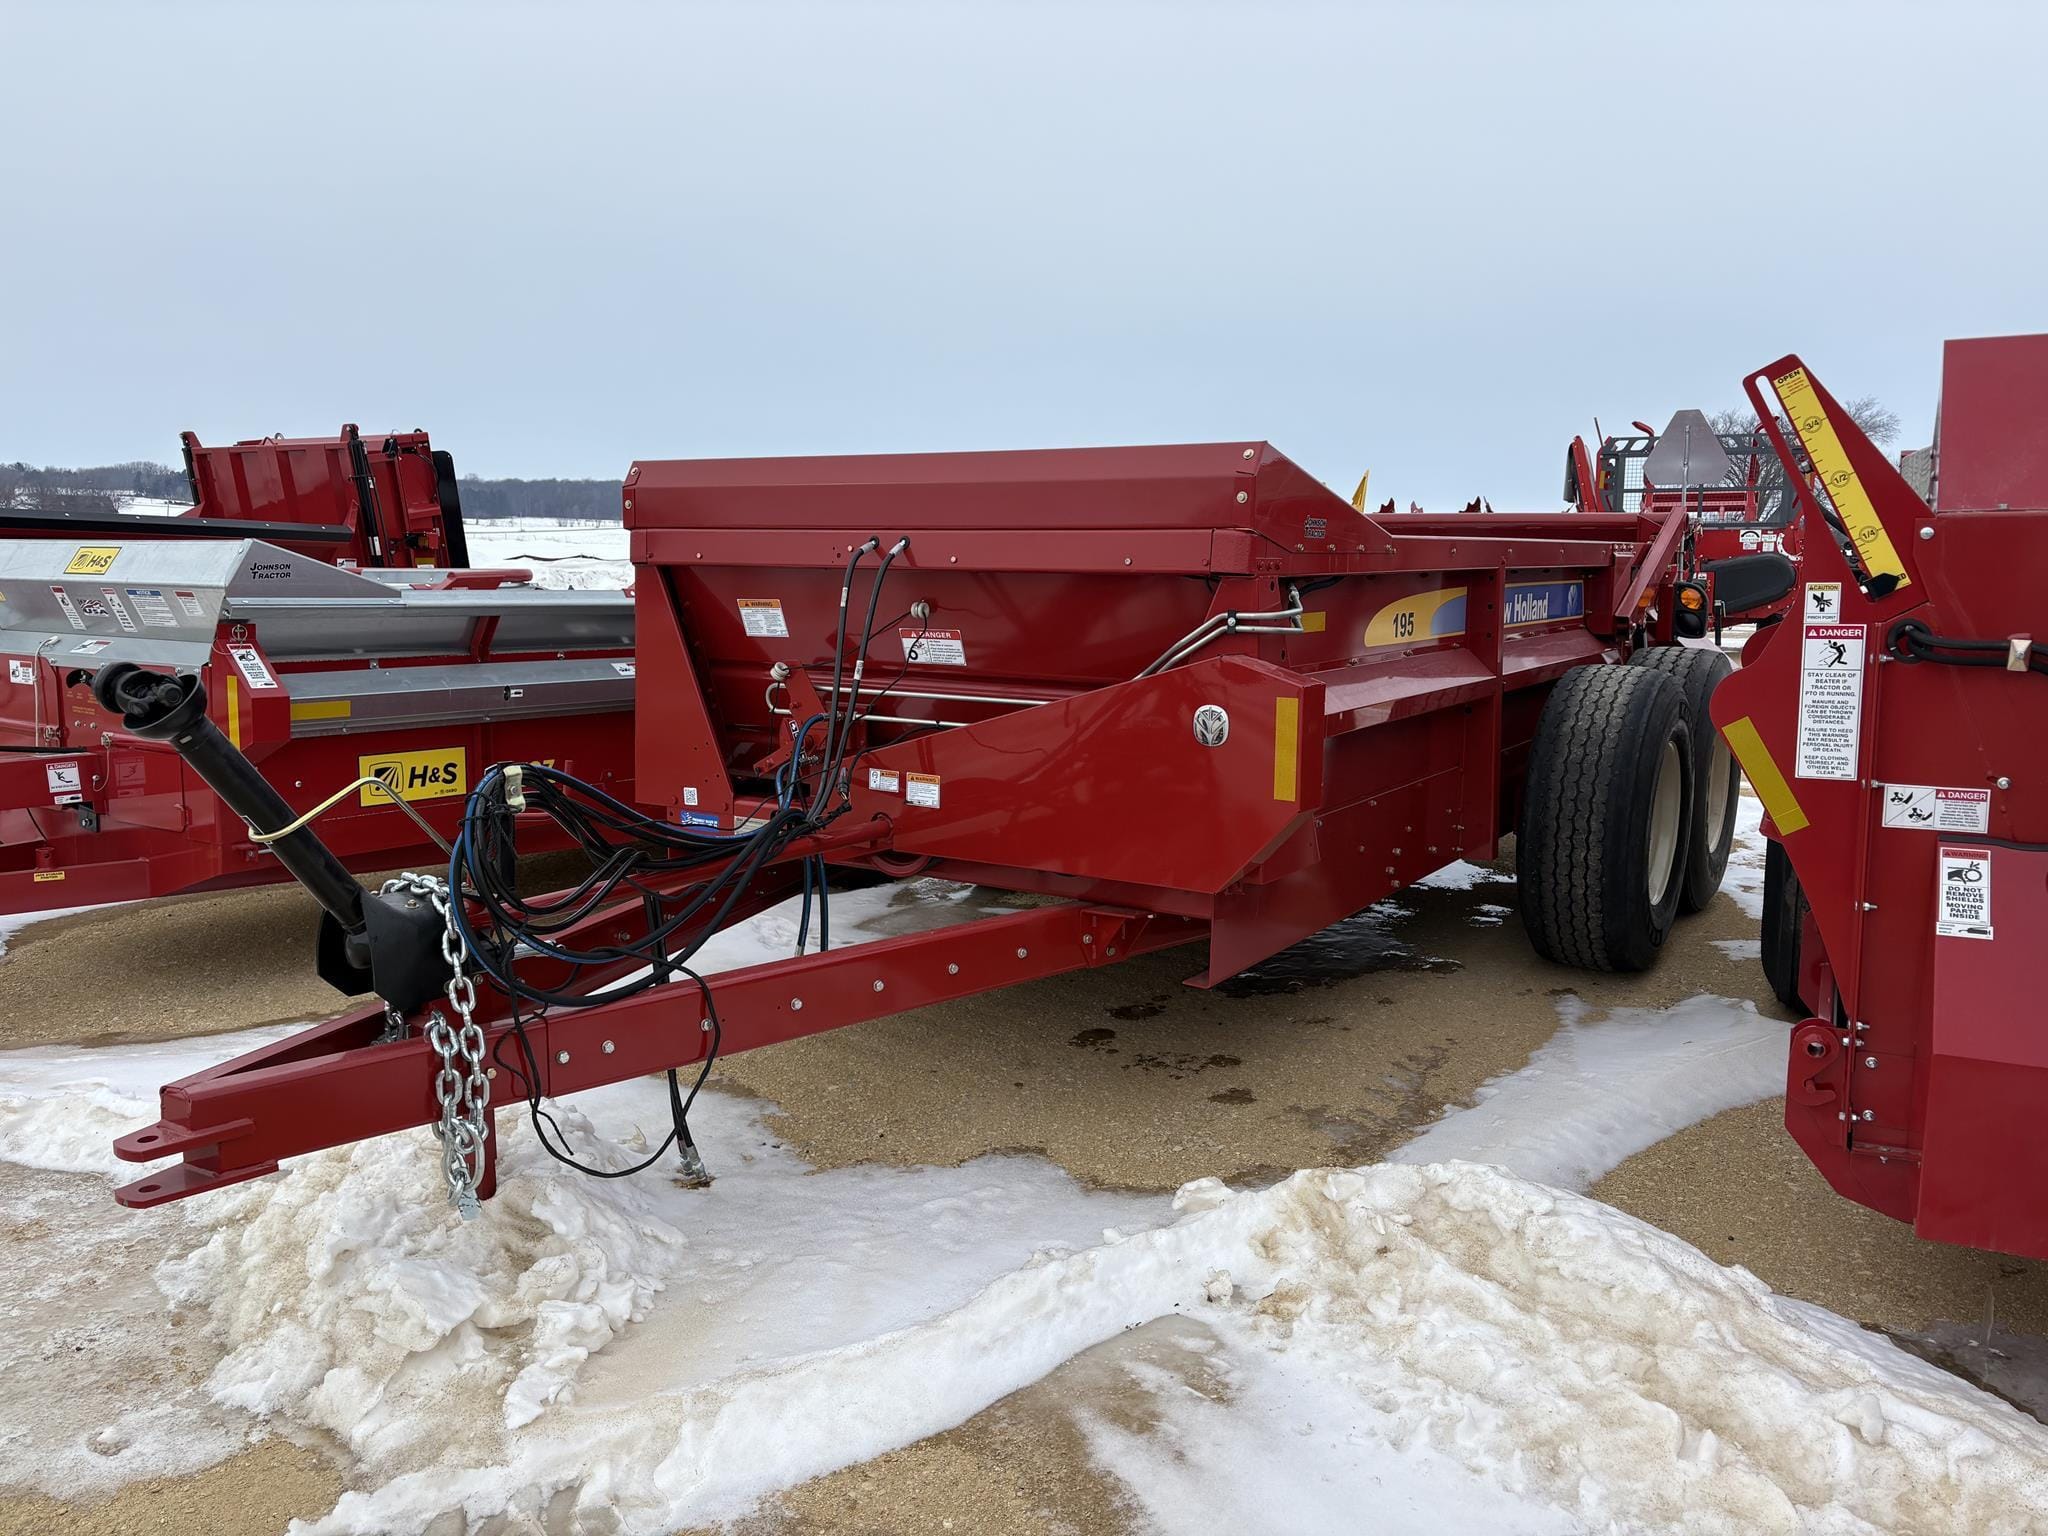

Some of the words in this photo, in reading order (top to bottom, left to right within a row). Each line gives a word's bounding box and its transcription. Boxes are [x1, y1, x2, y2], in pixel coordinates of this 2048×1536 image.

[1777, 370, 1801, 384] OPEN
[1806, 420, 1819, 430] 3/4
[1834, 473, 1848, 484] 1/2
[1862, 529, 1876, 540] 1/4
[86, 555, 112, 568] H&S
[1513, 591, 1549, 623] Holland
[1393, 612, 1415, 638] 195
[919, 631, 951, 639] DANGER
[1819, 628, 1862, 637] DANGER
[408, 762, 458, 788] H&S
[1947, 791, 1987, 800] DANGER
[1951, 851, 1988, 859] WARNING
[1946, 902, 1984, 910] MOVING
